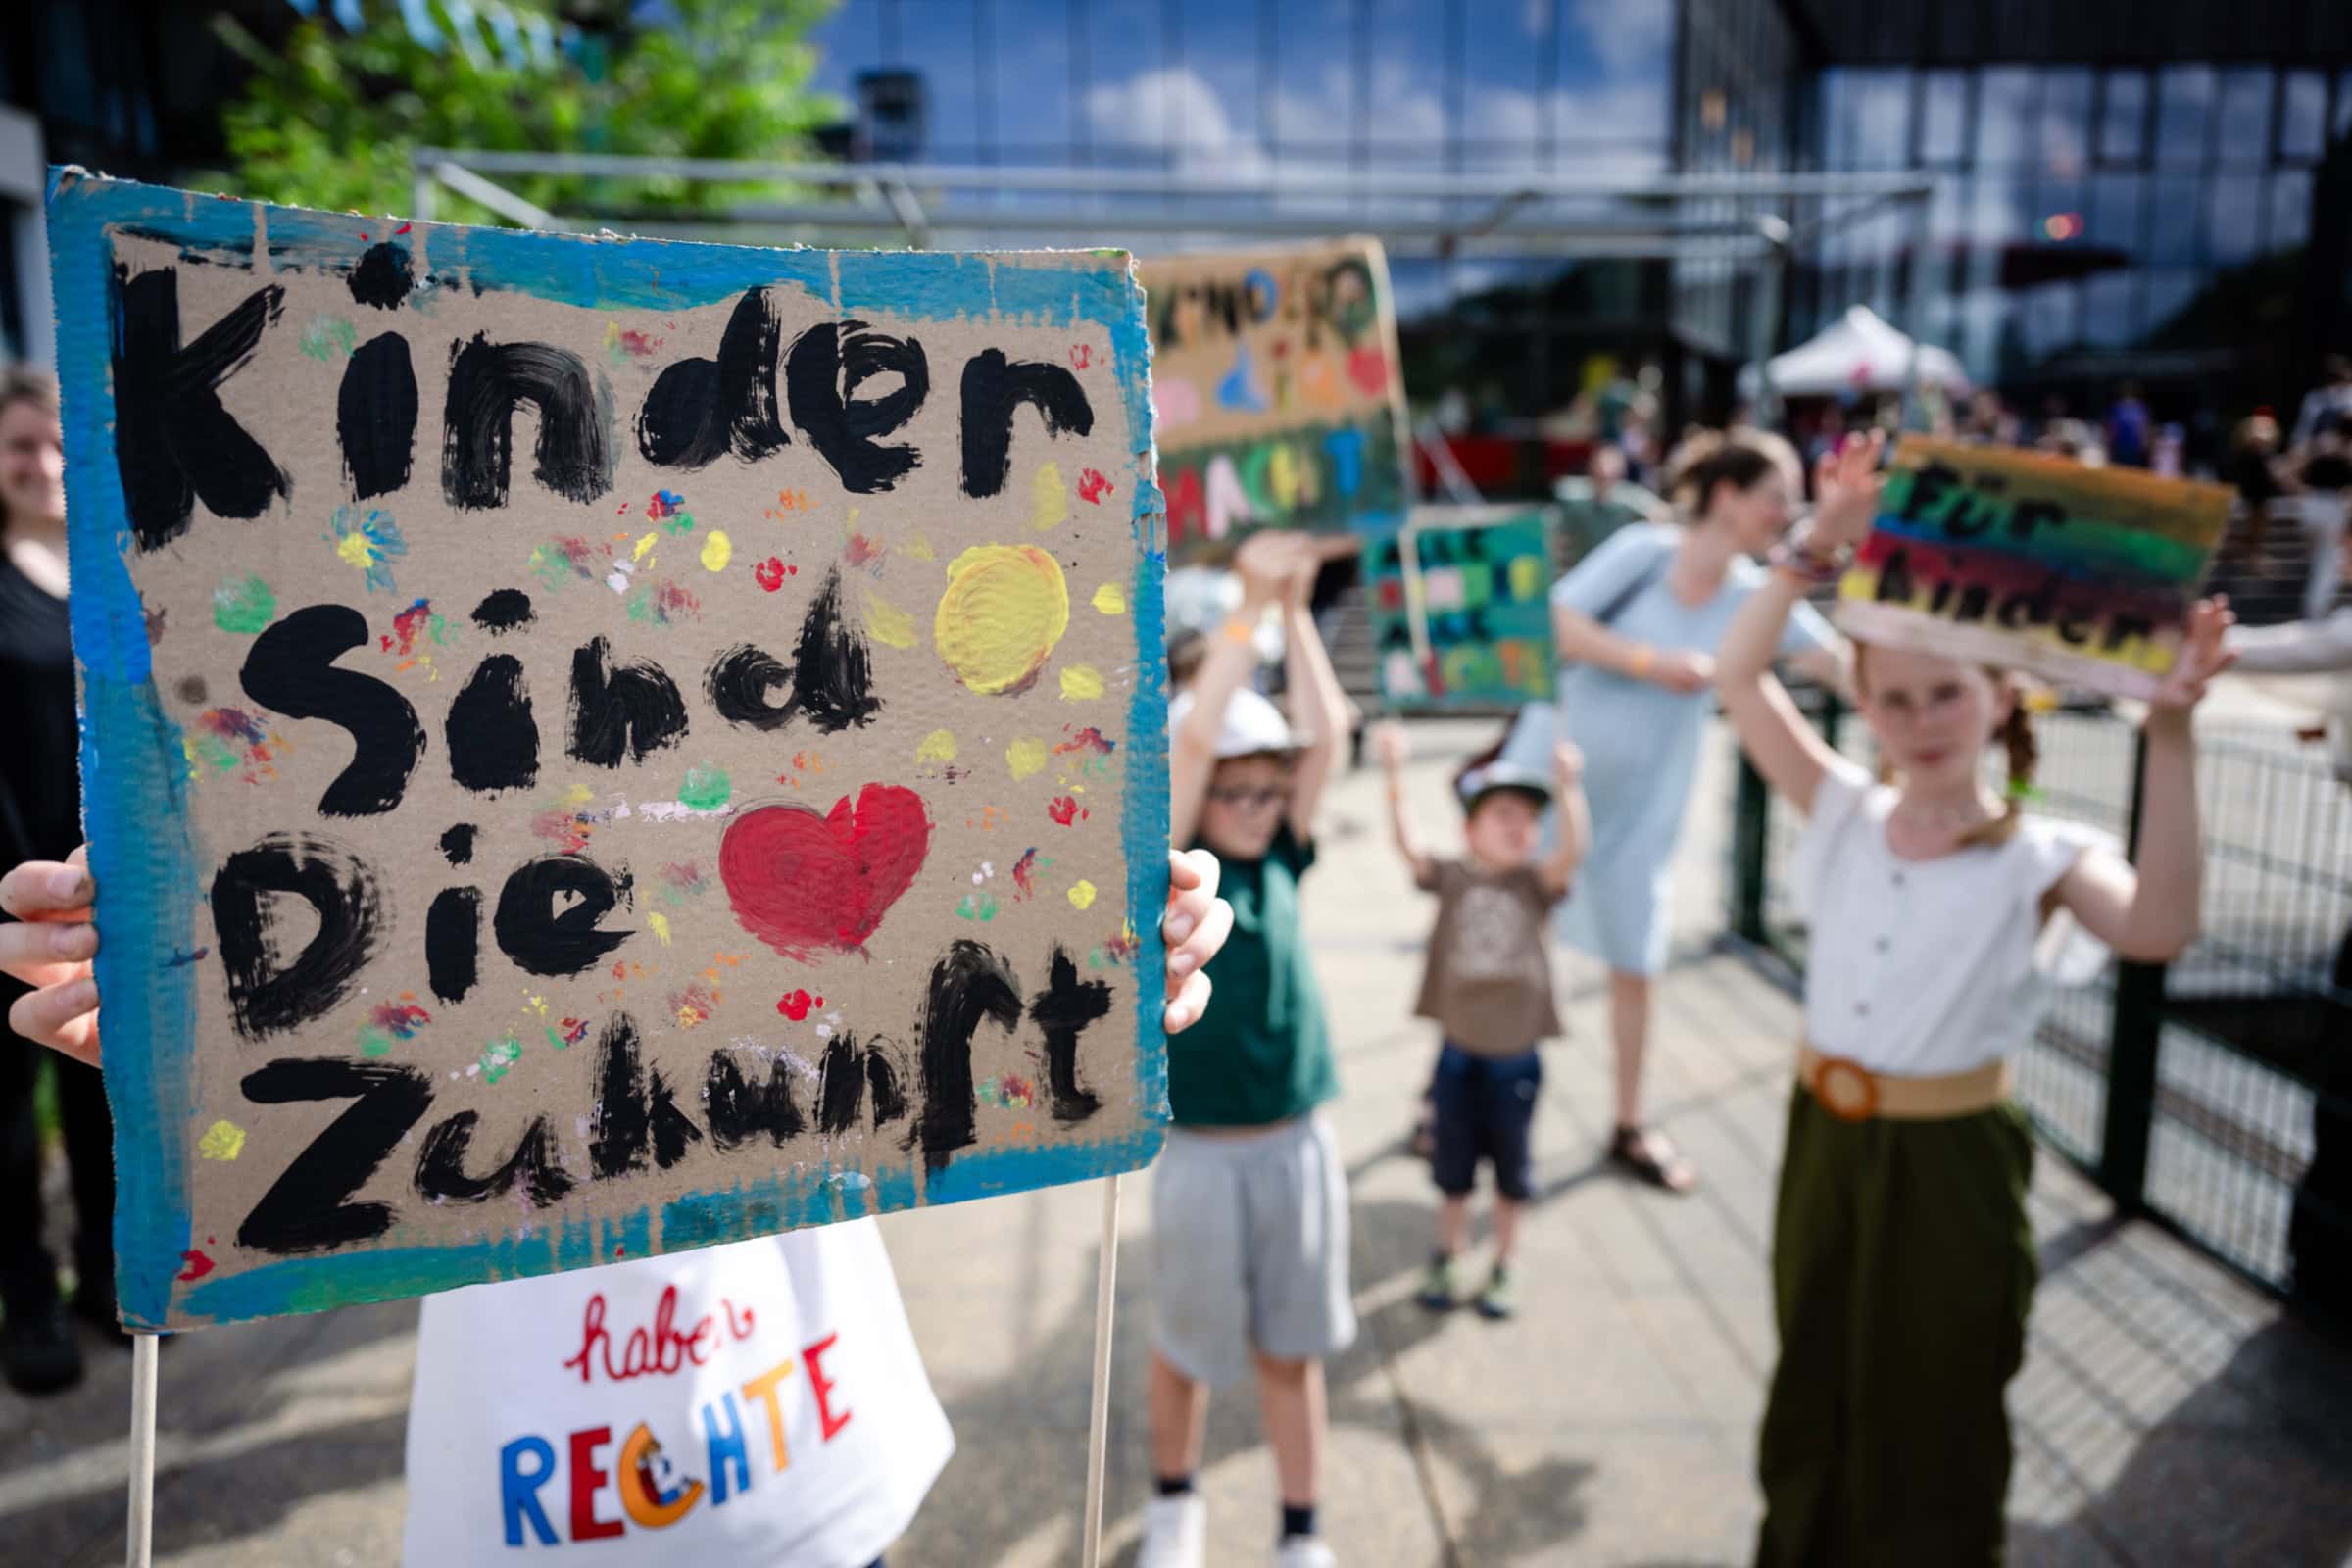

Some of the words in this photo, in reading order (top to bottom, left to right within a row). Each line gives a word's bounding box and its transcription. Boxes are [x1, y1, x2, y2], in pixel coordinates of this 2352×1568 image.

[110, 240, 1095, 553] Kinder
[1897, 460, 2066, 539] Für
[238, 562, 882, 818] Sind
[209, 821, 635, 1043] Die
[237, 938, 1114, 1255] Zukunft
[500, 1331, 852, 1547] RECHTE
